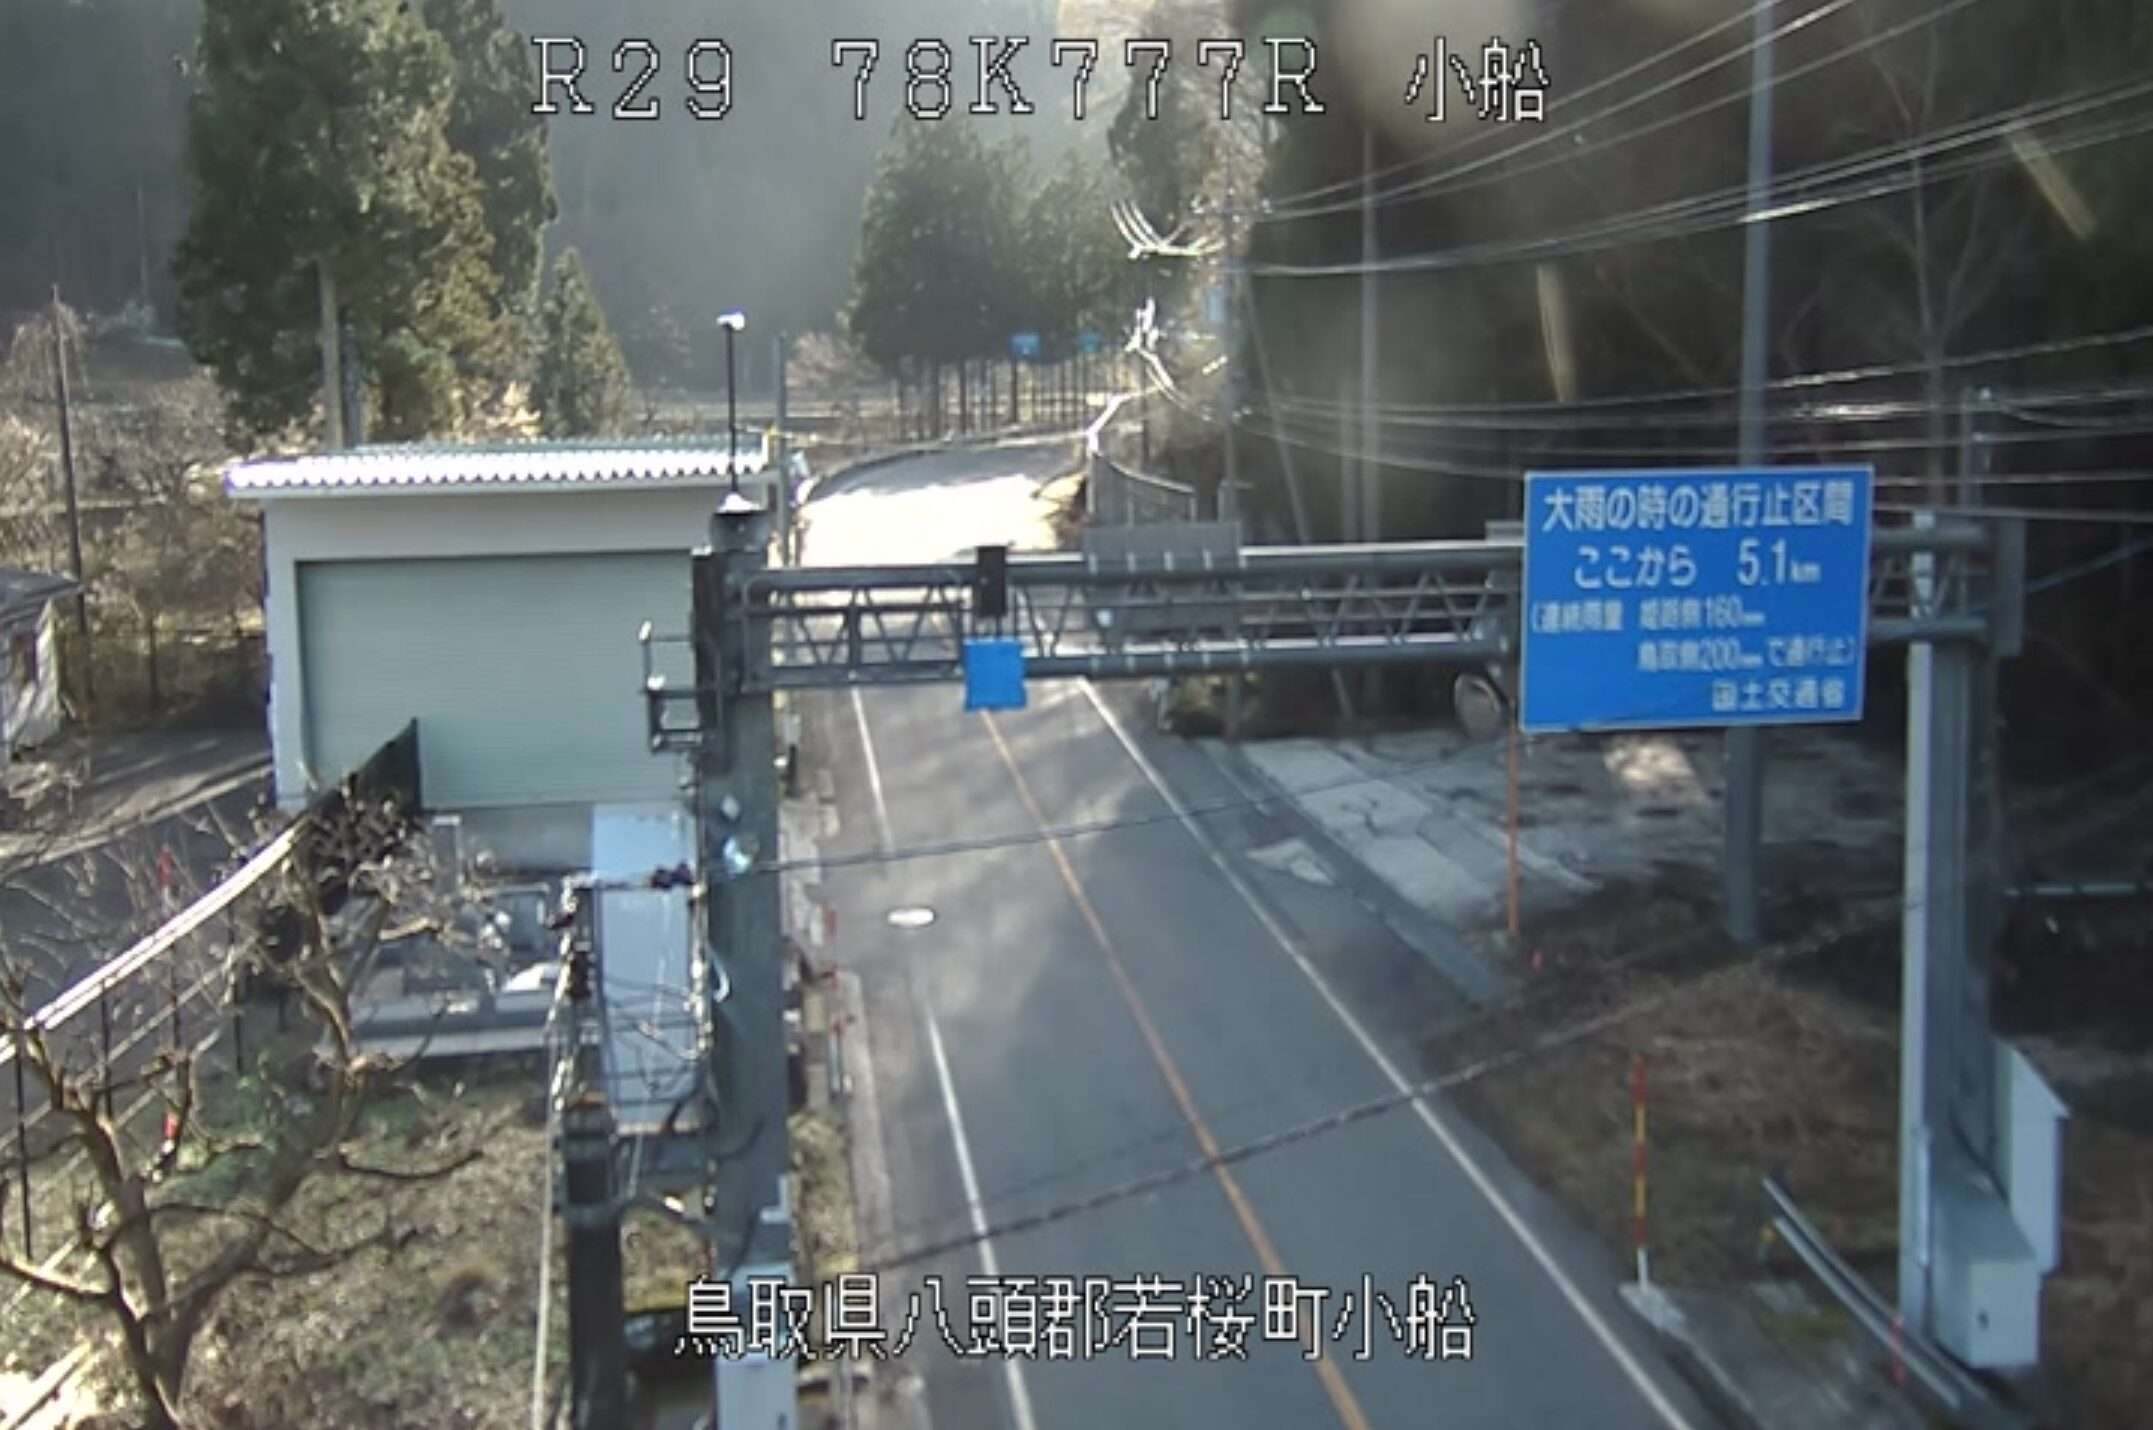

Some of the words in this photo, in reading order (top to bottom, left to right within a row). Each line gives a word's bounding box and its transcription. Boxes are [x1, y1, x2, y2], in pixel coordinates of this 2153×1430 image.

[1541, 480, 1855, 532] 大雨の時の通行止区間
[1573, 544, 1698, 590] ここから
